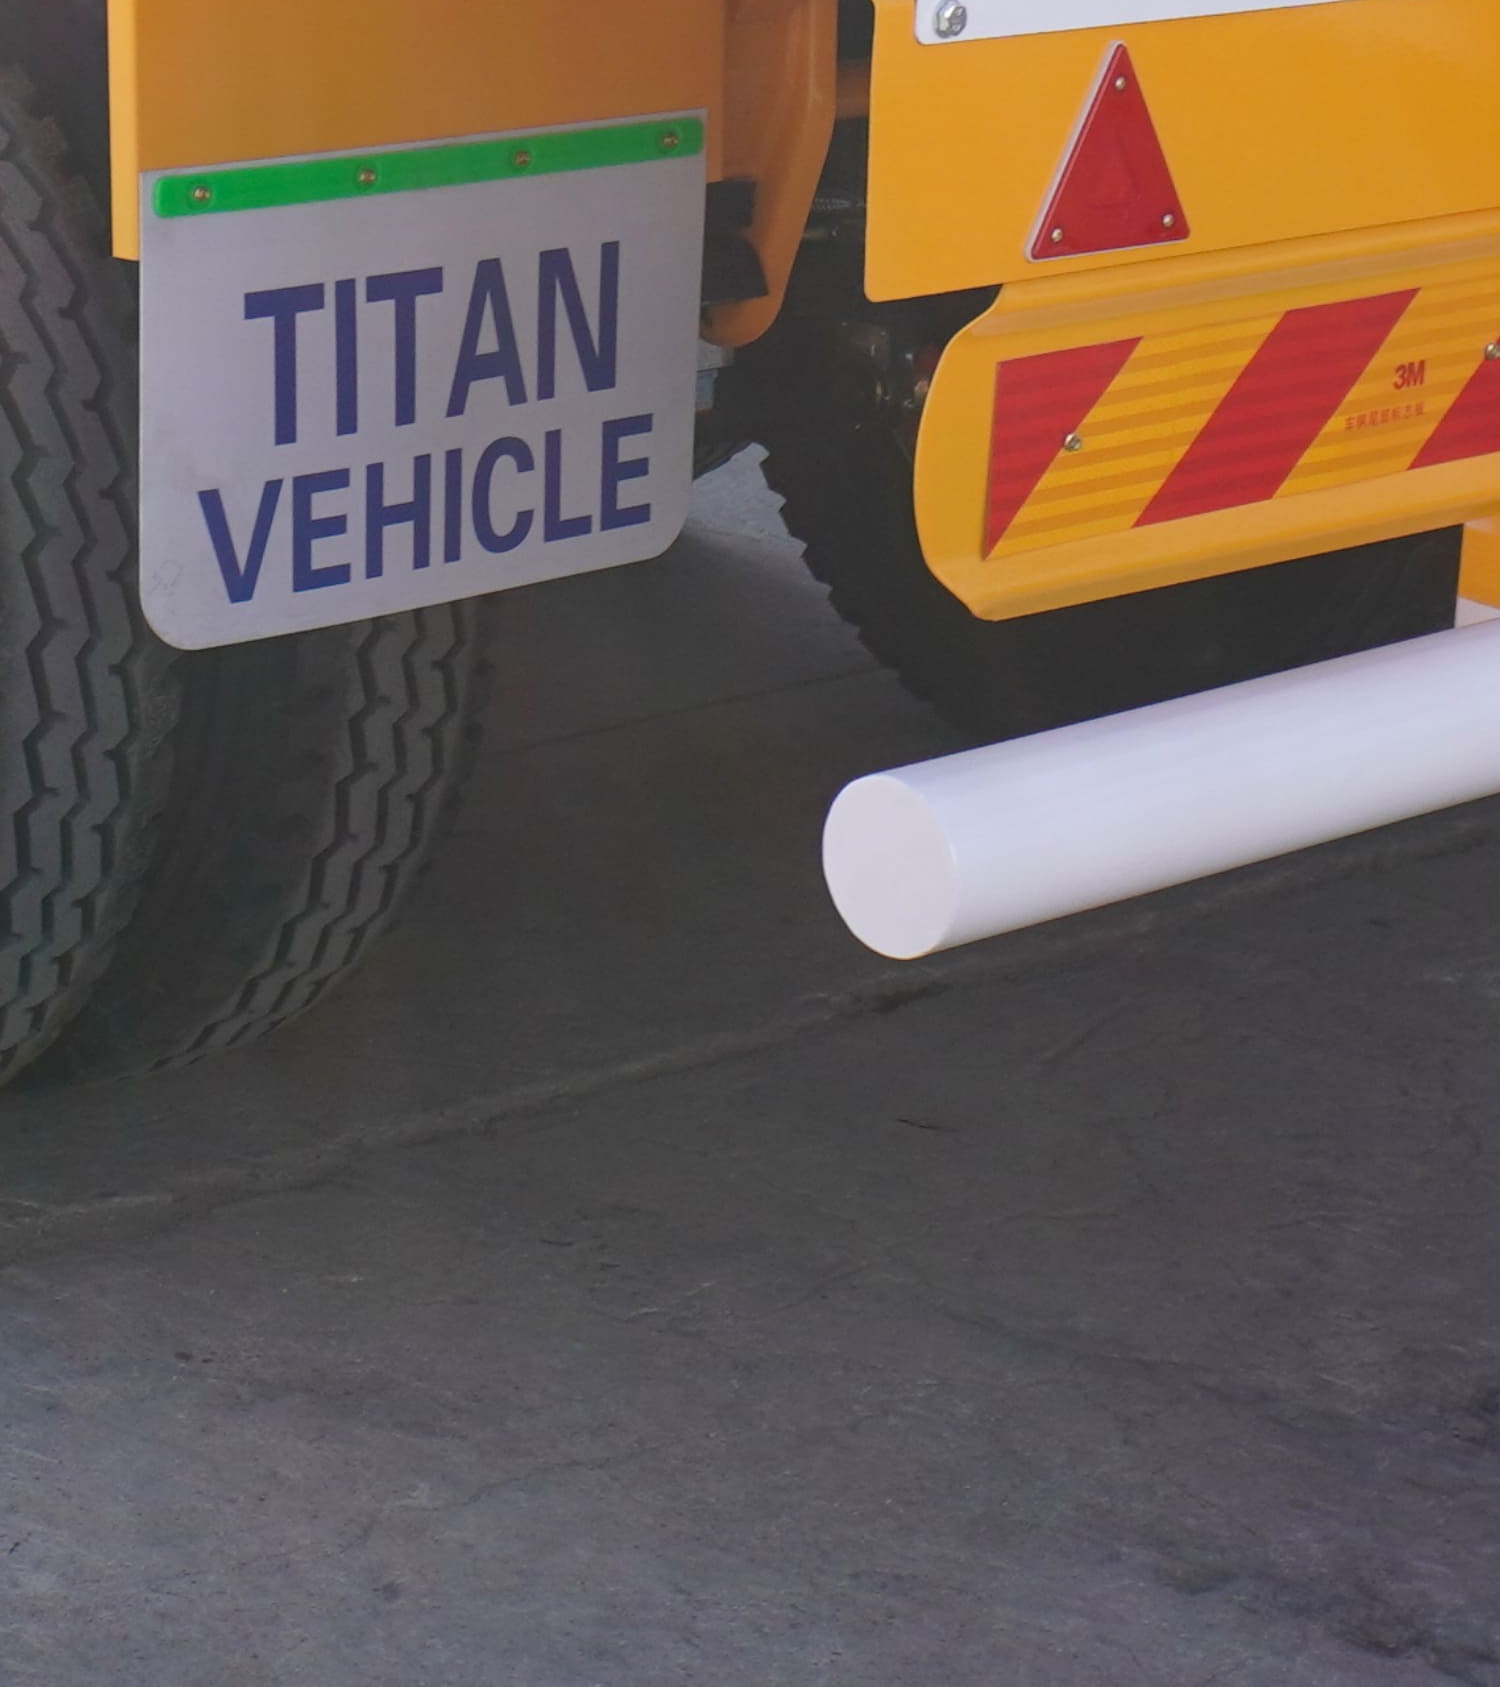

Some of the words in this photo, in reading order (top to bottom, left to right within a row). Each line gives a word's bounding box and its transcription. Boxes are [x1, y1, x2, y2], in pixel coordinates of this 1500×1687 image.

[243, 240, 620, 447] TITAN
[1393, 359, 1426, 390] 3M
[198, 413, 654, 605] VEHICLE
